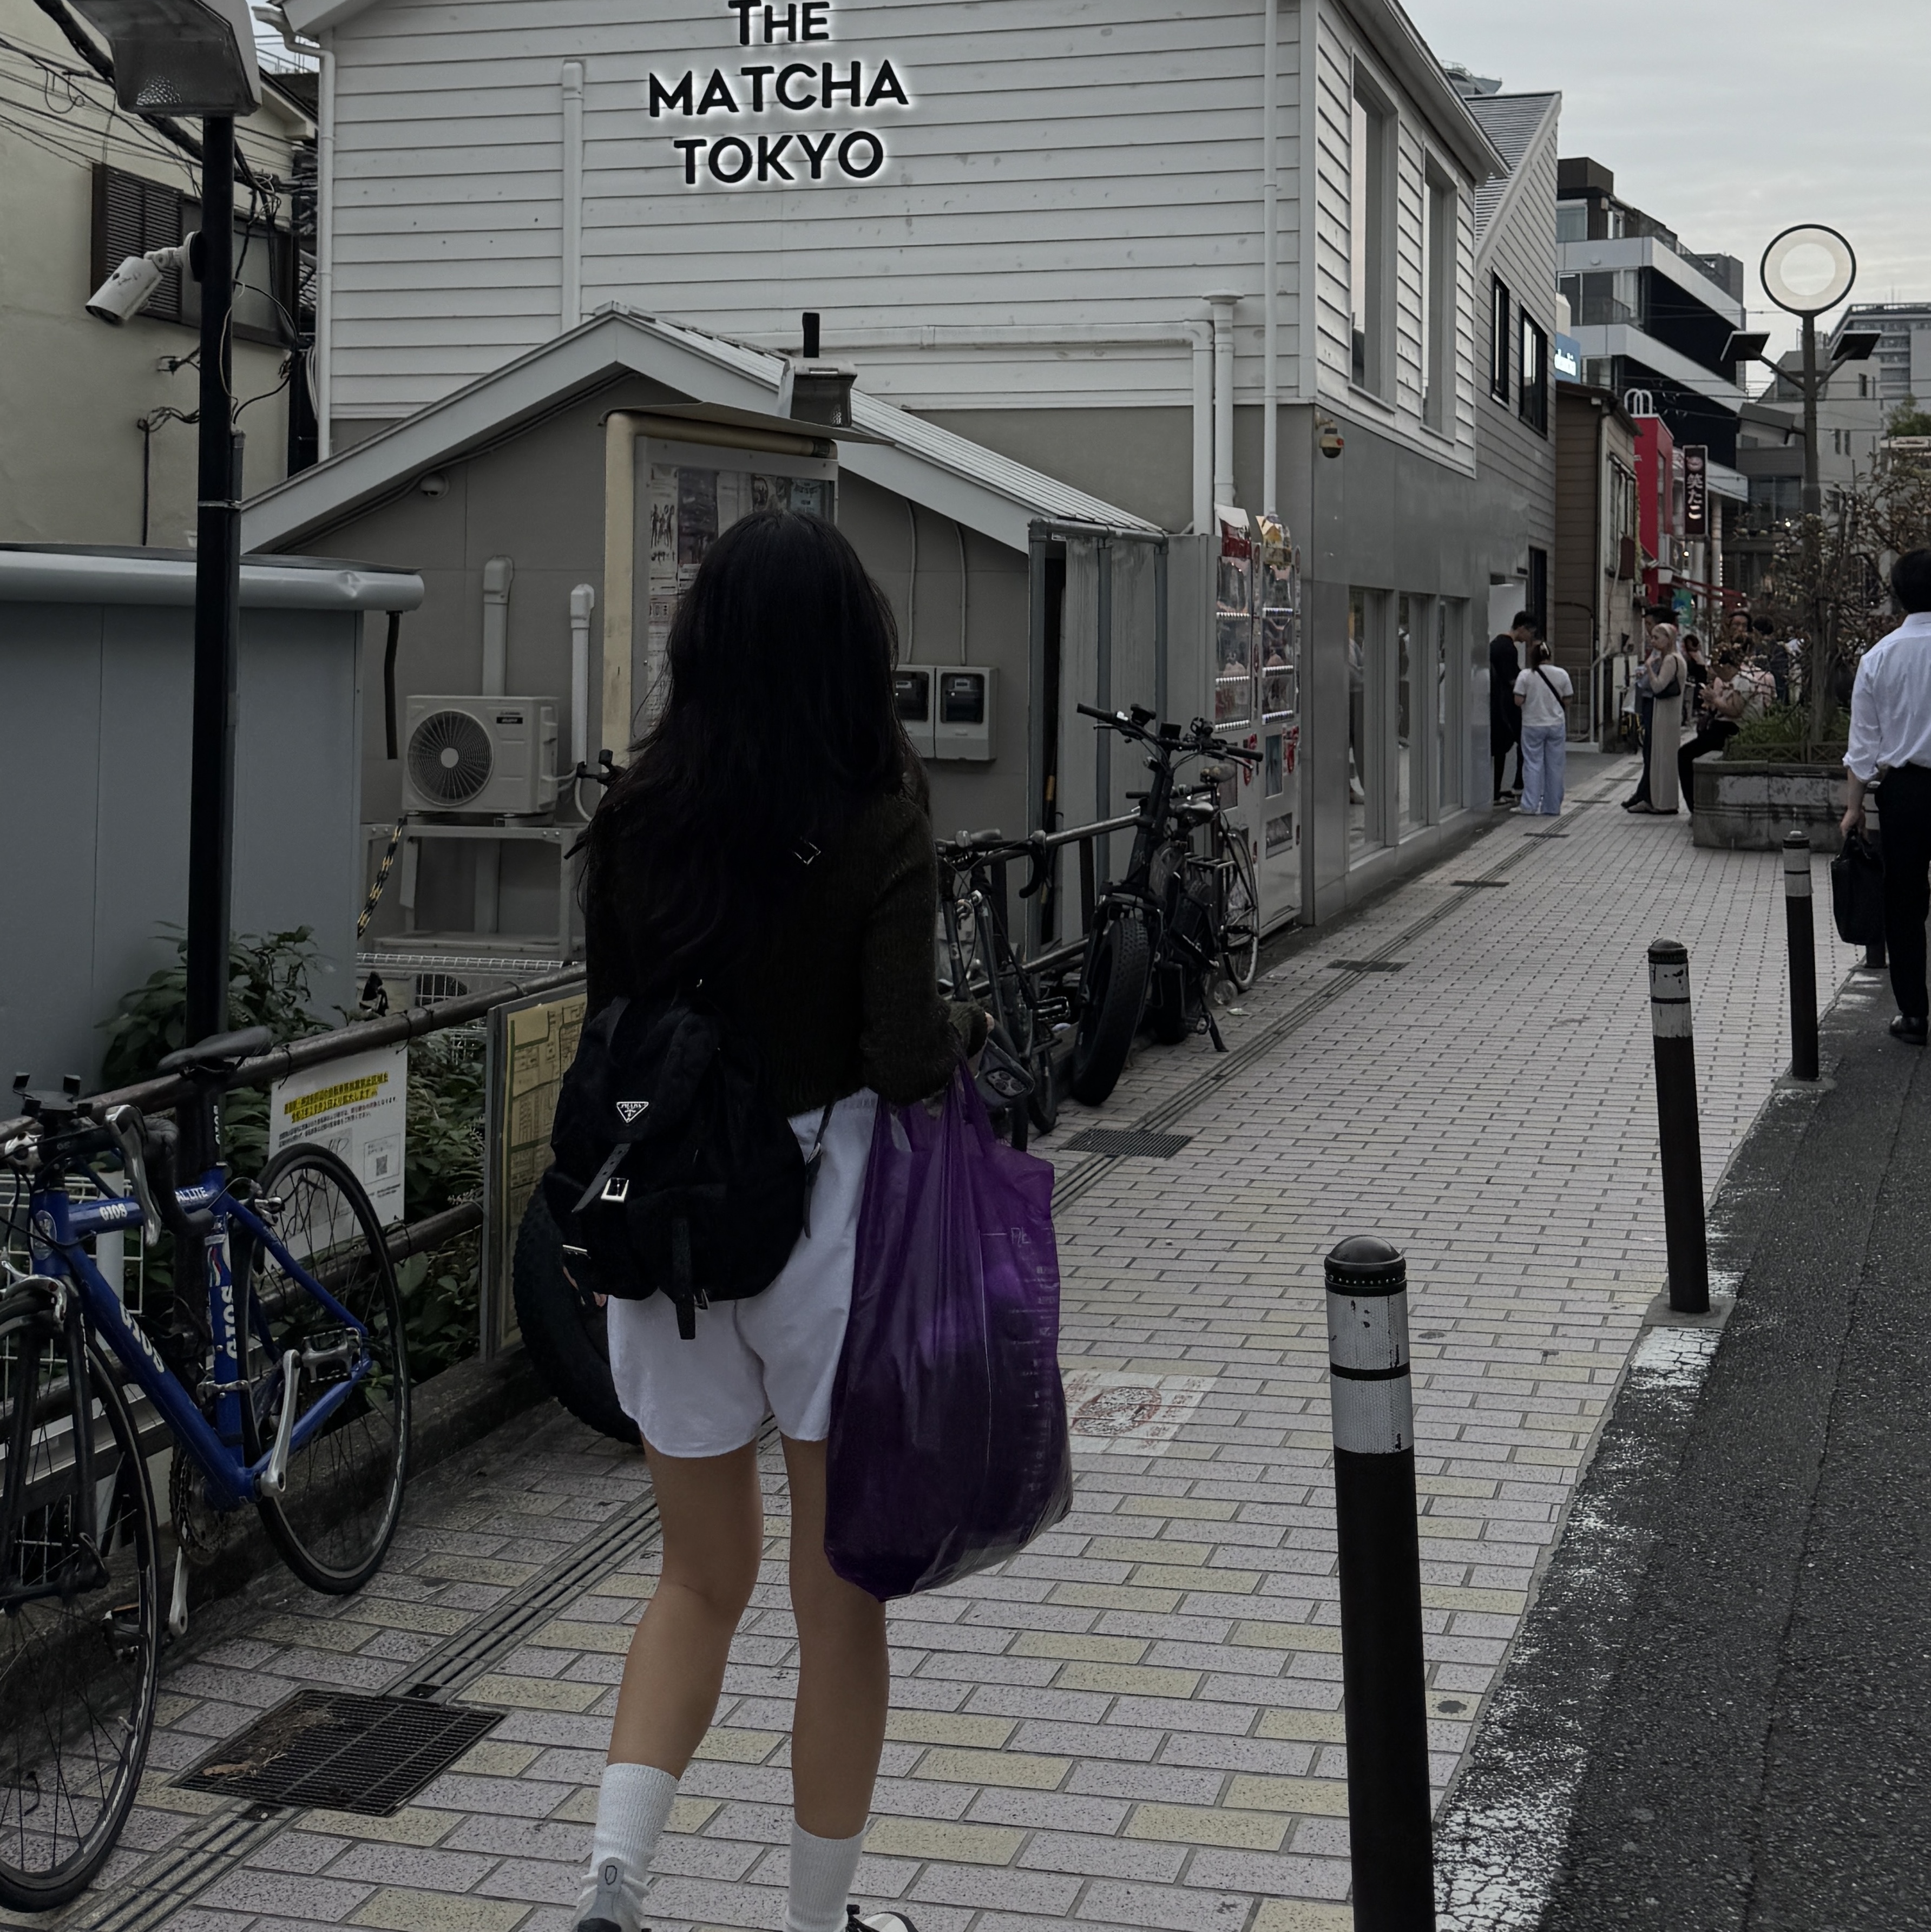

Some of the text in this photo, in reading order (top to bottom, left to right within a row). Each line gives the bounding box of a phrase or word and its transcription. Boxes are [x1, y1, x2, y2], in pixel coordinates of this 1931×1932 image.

[728, 0, 830, 45] THE
[649, 59, 909, 117] MATCHA
[674, 131, 883, 184] TOKYO
[1686, 473, 1703, 520] 笑たこ
